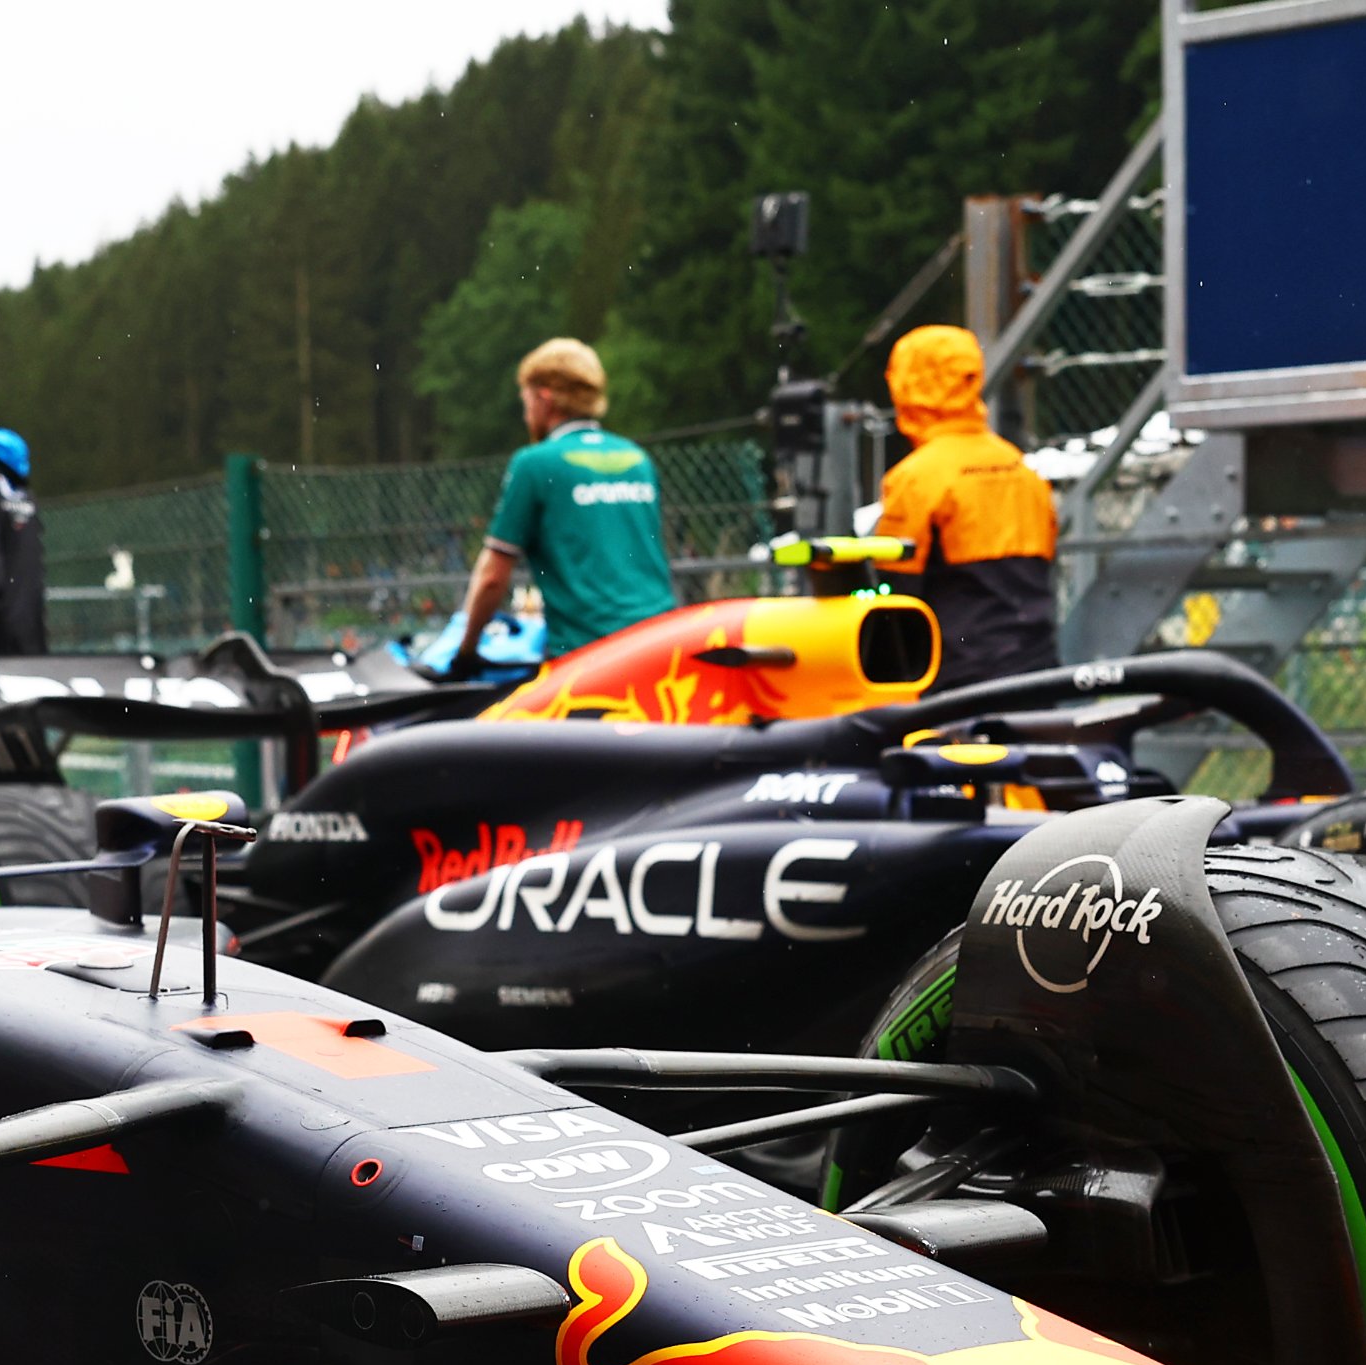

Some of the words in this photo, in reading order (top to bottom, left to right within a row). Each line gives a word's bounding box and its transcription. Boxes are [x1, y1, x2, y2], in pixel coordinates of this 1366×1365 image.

[269, 812, 368, 842] HONDA
[424, 838, 867, 942] ORACLE
[981, 879, 1077, 928] Hard
[1069, 884, 1162, 944] Rock
[397, 1111, 620, 1149] VISA
[482, 1150, 631, 1183] CDW
[682, 1205, 806, 1231] ARCTIC
[719, 1218, 818, 1242] WOLF
[676, 1236, 889, 1281] PIRELLI
[729, 1262, 938, 1301] infinitum
[776, 1289, 940, 1329] Mobil
